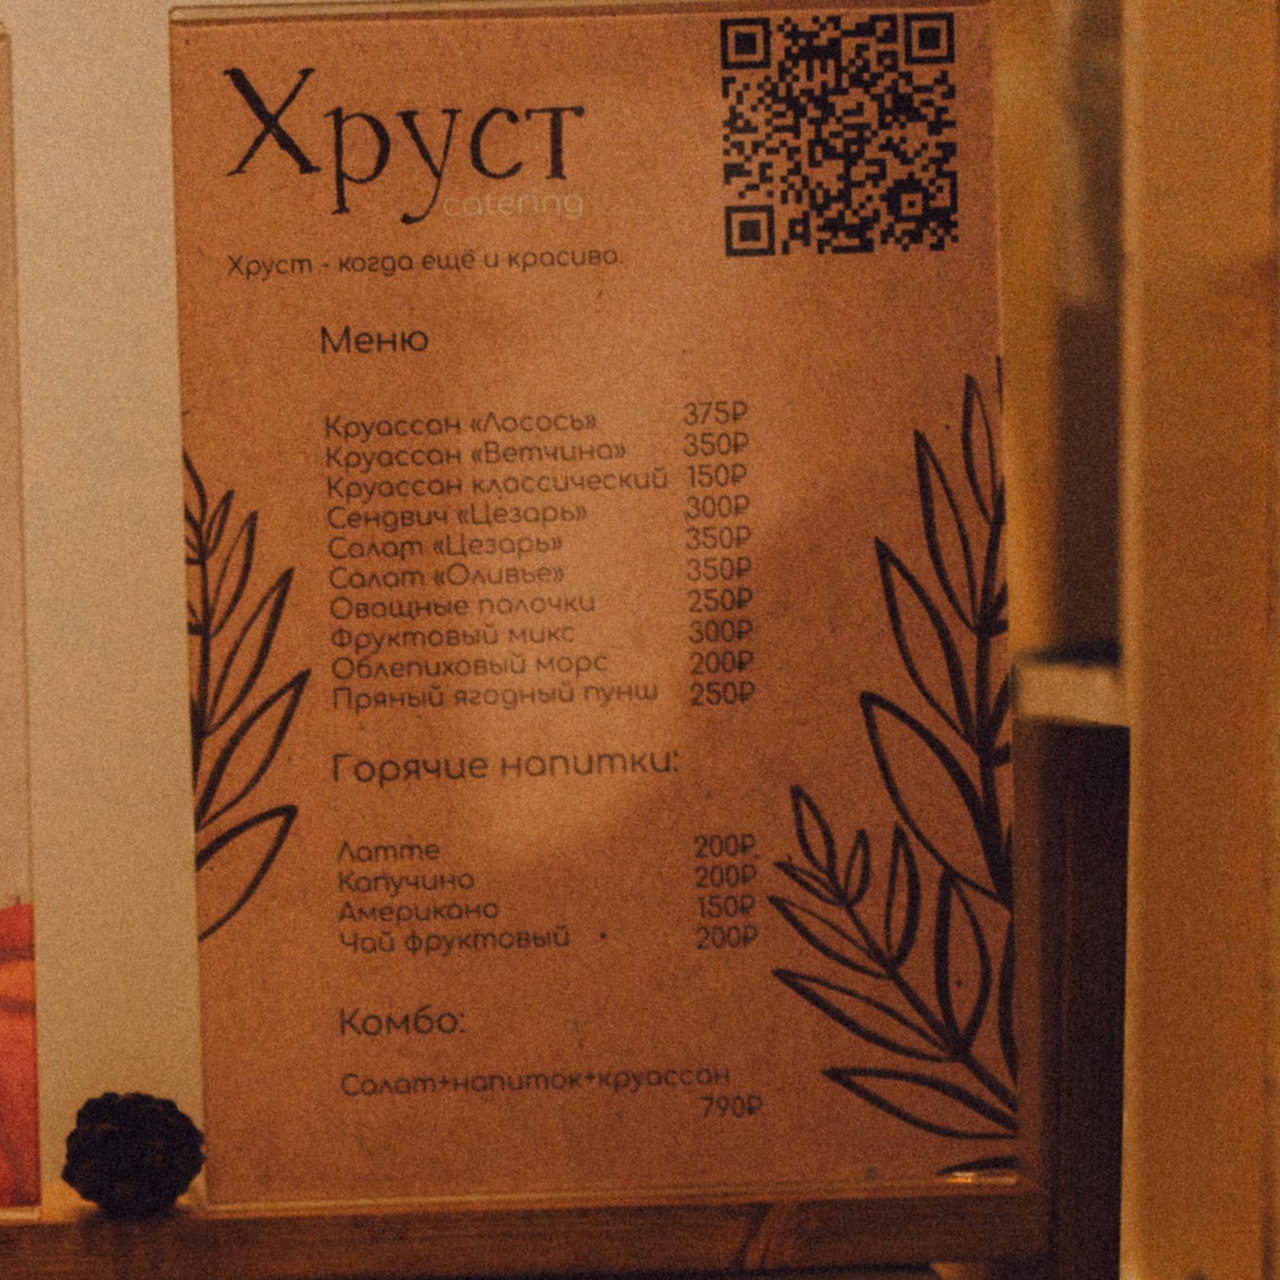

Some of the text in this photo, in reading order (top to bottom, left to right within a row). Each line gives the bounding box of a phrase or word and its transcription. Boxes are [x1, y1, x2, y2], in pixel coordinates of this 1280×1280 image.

[224, 66, 586, 225] Хруст
[442, 190, 586, 222] catering
[227, 254, 314, 281] Хруст
[338, 251, 414, 277] когда
[421, 245, 477, 274] ещё
[483, 253, 501, 269] и
[320, 324, 430, 356] Меню
[325, 416, 462, 443] Круассан
[325, 445, 462, 474] Круассан
[327, 476, 463, 504] Круассан
[472, 467, 669, 495] классический
[327, 505, 449, 533] Сендвич
[328, 535, 423, 561] Салат
[329, 565, 423, 592] Салат
[329, 595, 470, 623] Овощные
[478, 594, 596, 616] палочки
[330, 624, 499, 655] Фруктовый
[507, 624, 575, 645] микс
[331, 653, 527, 681] Облепиховый
[536, 652, 609, 677] морс
[332, 684, 445, 716] Пряный
[453, 681, 575, 710] ягодный
[583, 682, 659, 709] пунш
[332, 748, 680, 790] Горячие напитки:
[336, 840, 442, 865] Латте
[338, 871, 475, 897] Капучино
[338, 901, 501, 927] Американо
[339, 929, 396, 955] Чай
[404, 925, 571, 957] фруктовый
[339, 1004, 466, 1037] Комбо:
